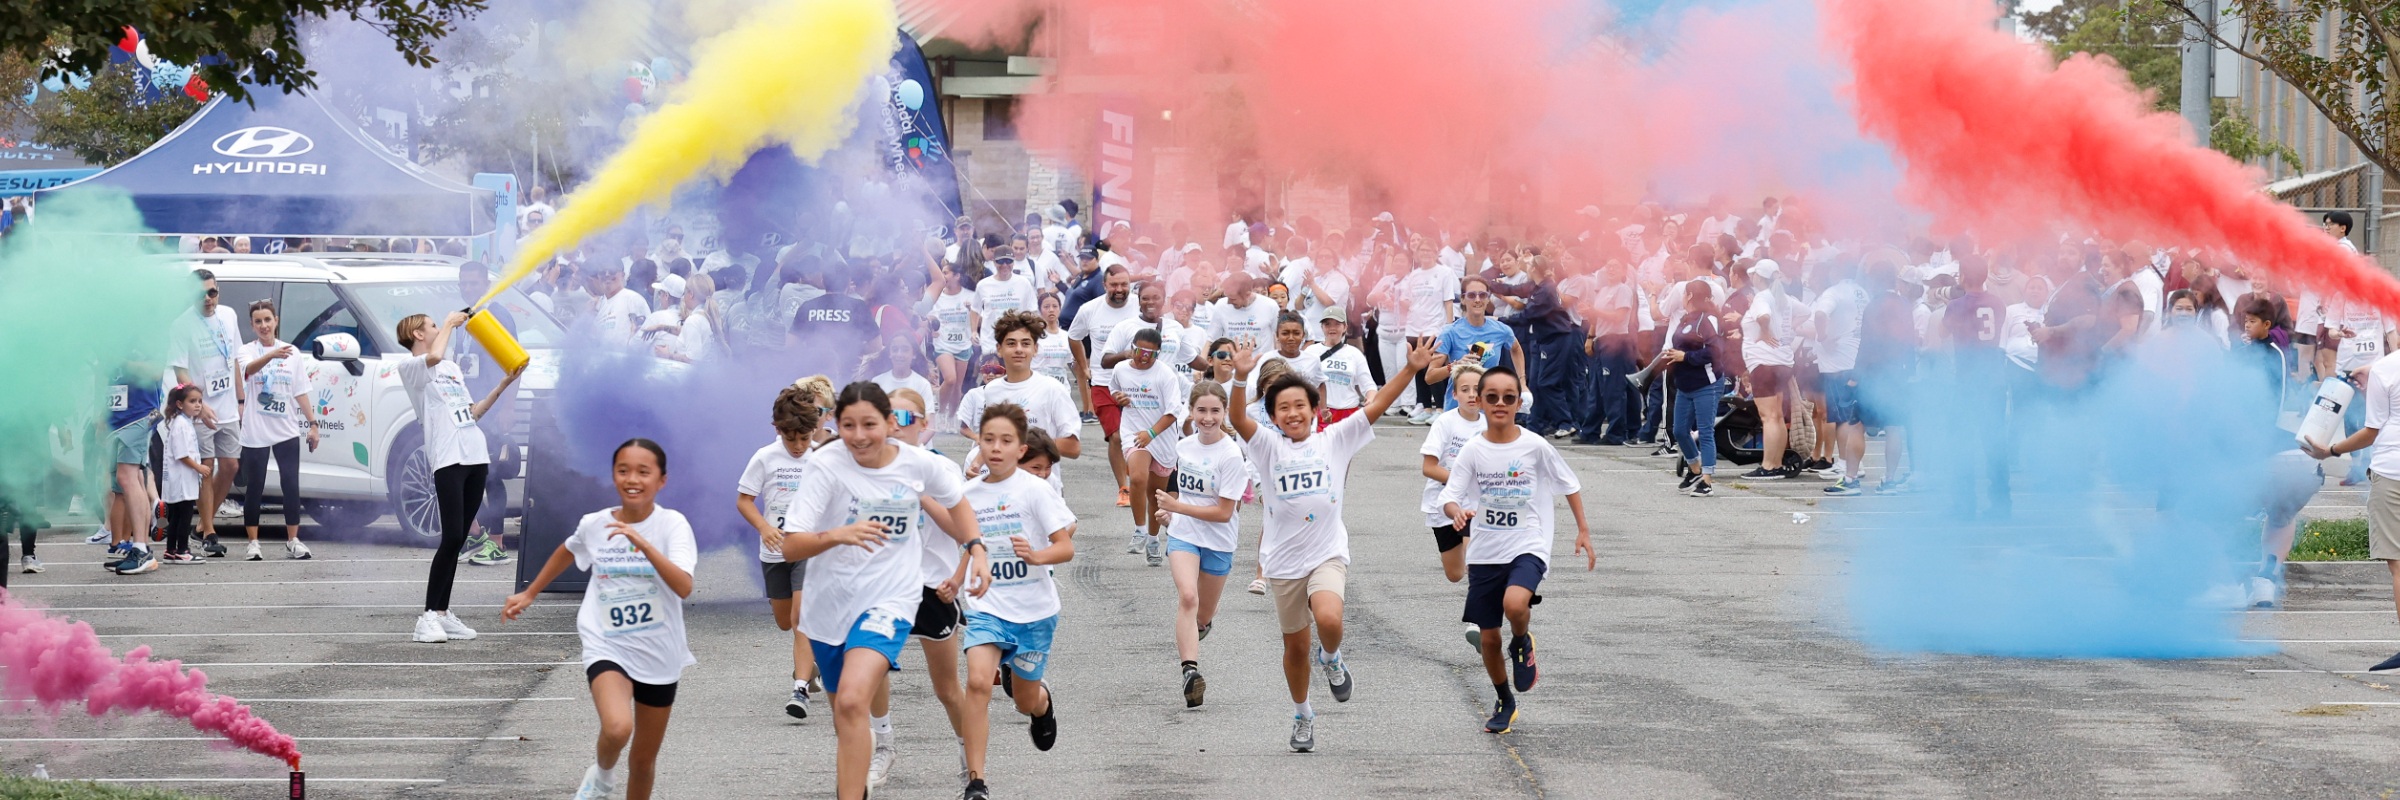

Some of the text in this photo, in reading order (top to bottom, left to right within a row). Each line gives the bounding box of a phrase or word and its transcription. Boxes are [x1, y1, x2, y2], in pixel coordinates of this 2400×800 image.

[193, 161, 327, 176] HYUNDAI
[495, 192, 508, 207] ghts
[808, 308, 851, 322] PRESS
[1976, 307, 1996, 341] 3
[947, 333, 963, 342] 230
[2355, 341, 2376, 352] 719
[1326, 360, 1347, 371] 285
[211, 377, 230, 392] 247
[1179, 472, 1205, 493] 934
[1278, 470, 1323, 493] 1757
[1485, 509, 1518, 527] 526
[990, 560, 1028, 580] 400
[610, 603, 654, 627] 932
